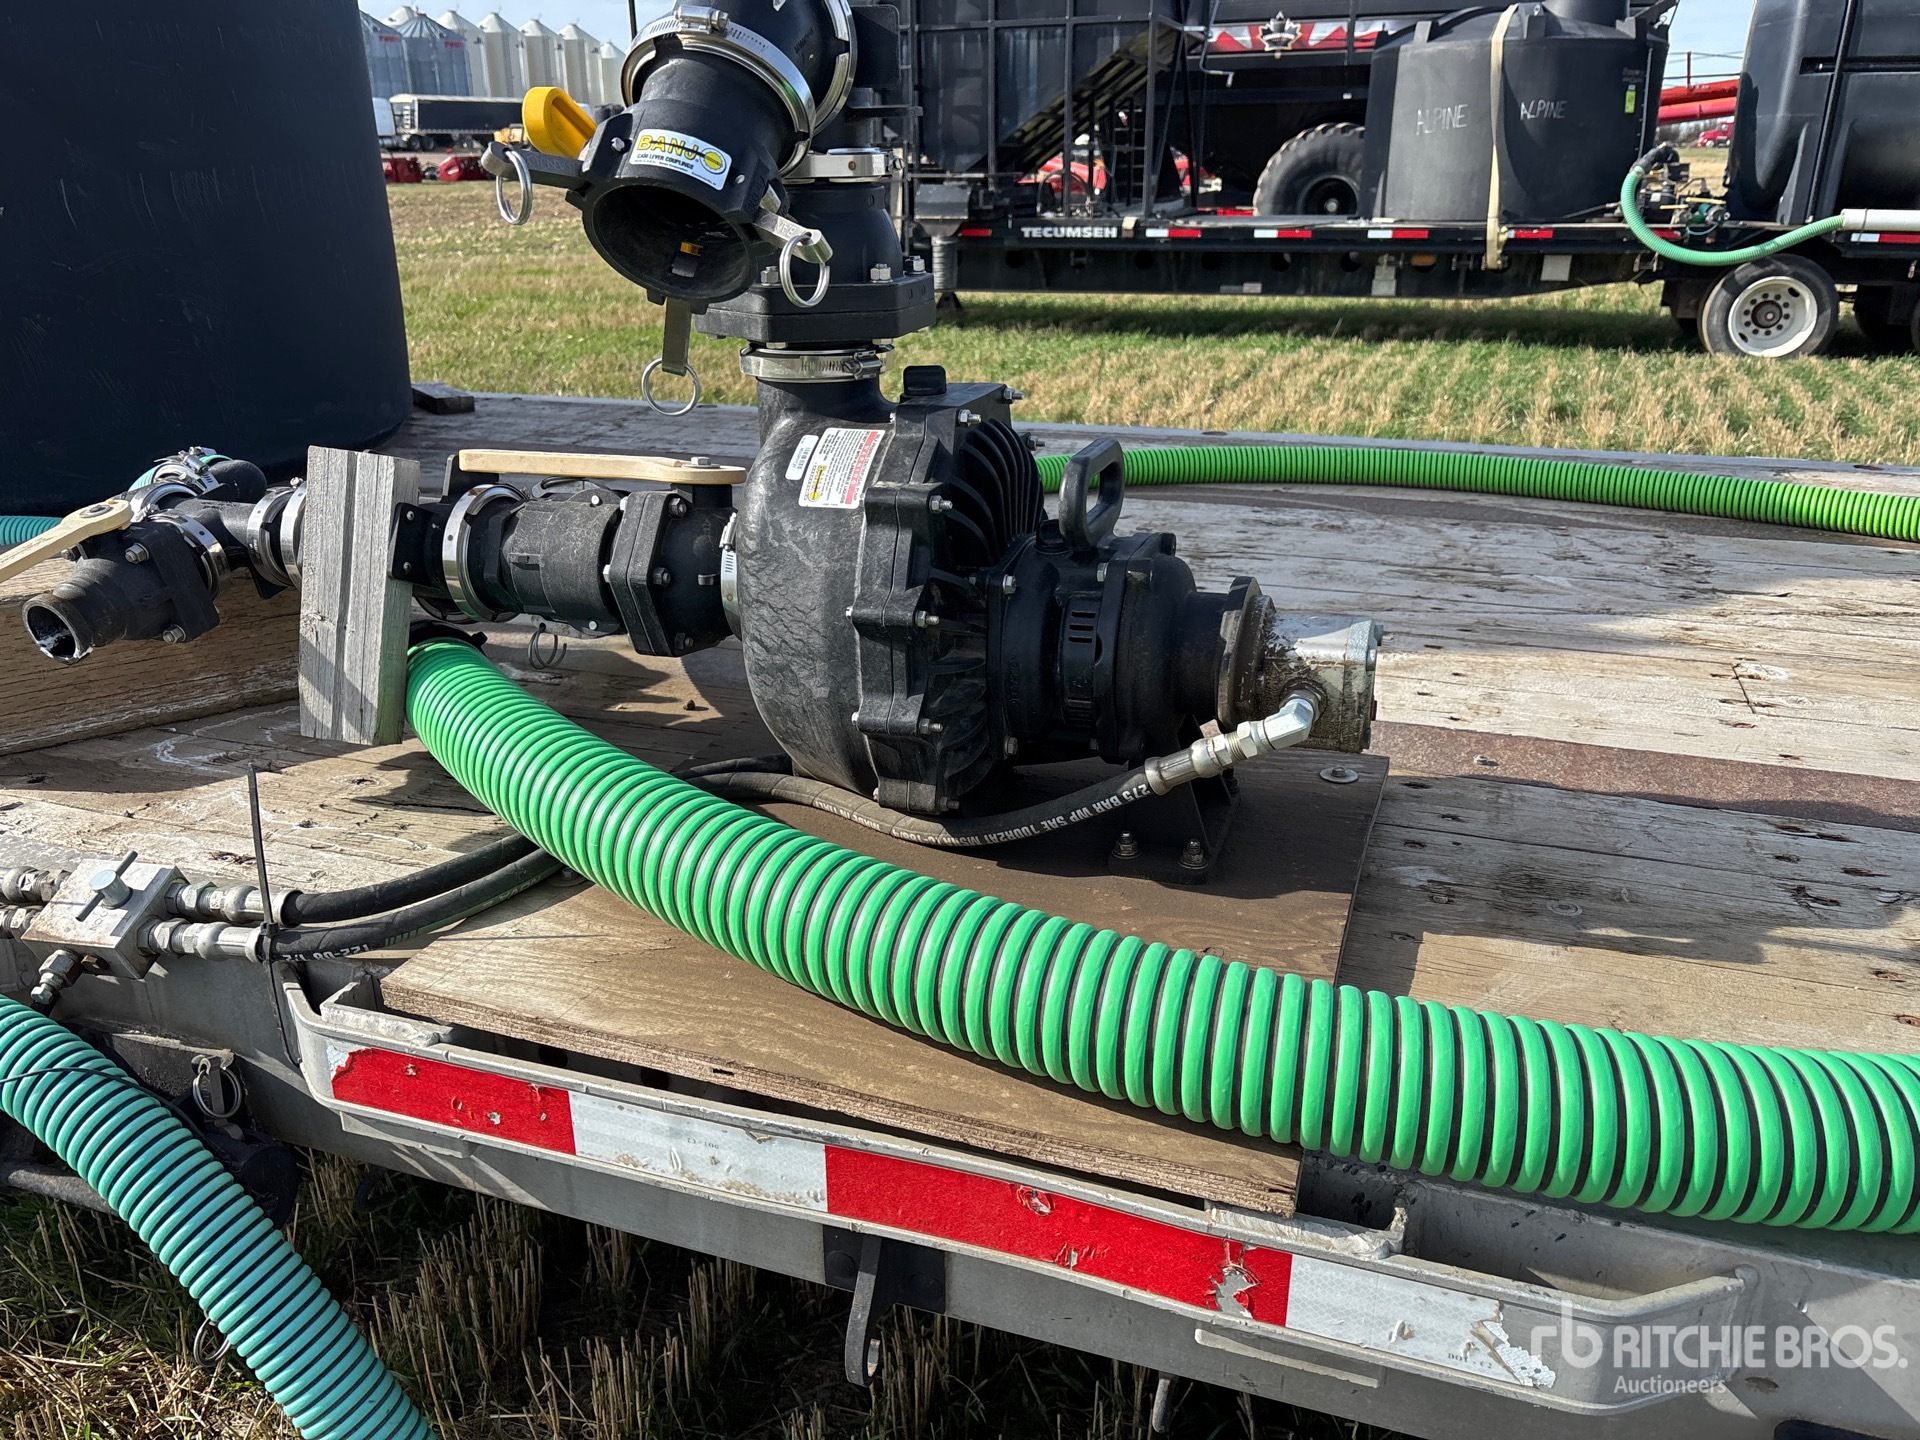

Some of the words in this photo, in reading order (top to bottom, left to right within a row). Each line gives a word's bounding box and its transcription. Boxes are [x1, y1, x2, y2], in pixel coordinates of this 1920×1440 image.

[1520, 99, 1568, 121] ALPINE
[1416, 103, 1469, 136] ALPINE
[637, 135, 728, 175] BANJO
[665, 156, 695, 170] COUPLINGS
[1020, 227, 1118, 239] TECUMSEH
[850, 445, 869, 485] WARNING
[1122, 784, 1150, 801] 275
[1092, 795, 1122, 813] BAR
[1069, 806, 1093, 822] WP
[1040, 815, 1068, 832] SAE
[984, 824, 1040, 844] 100R2AT
